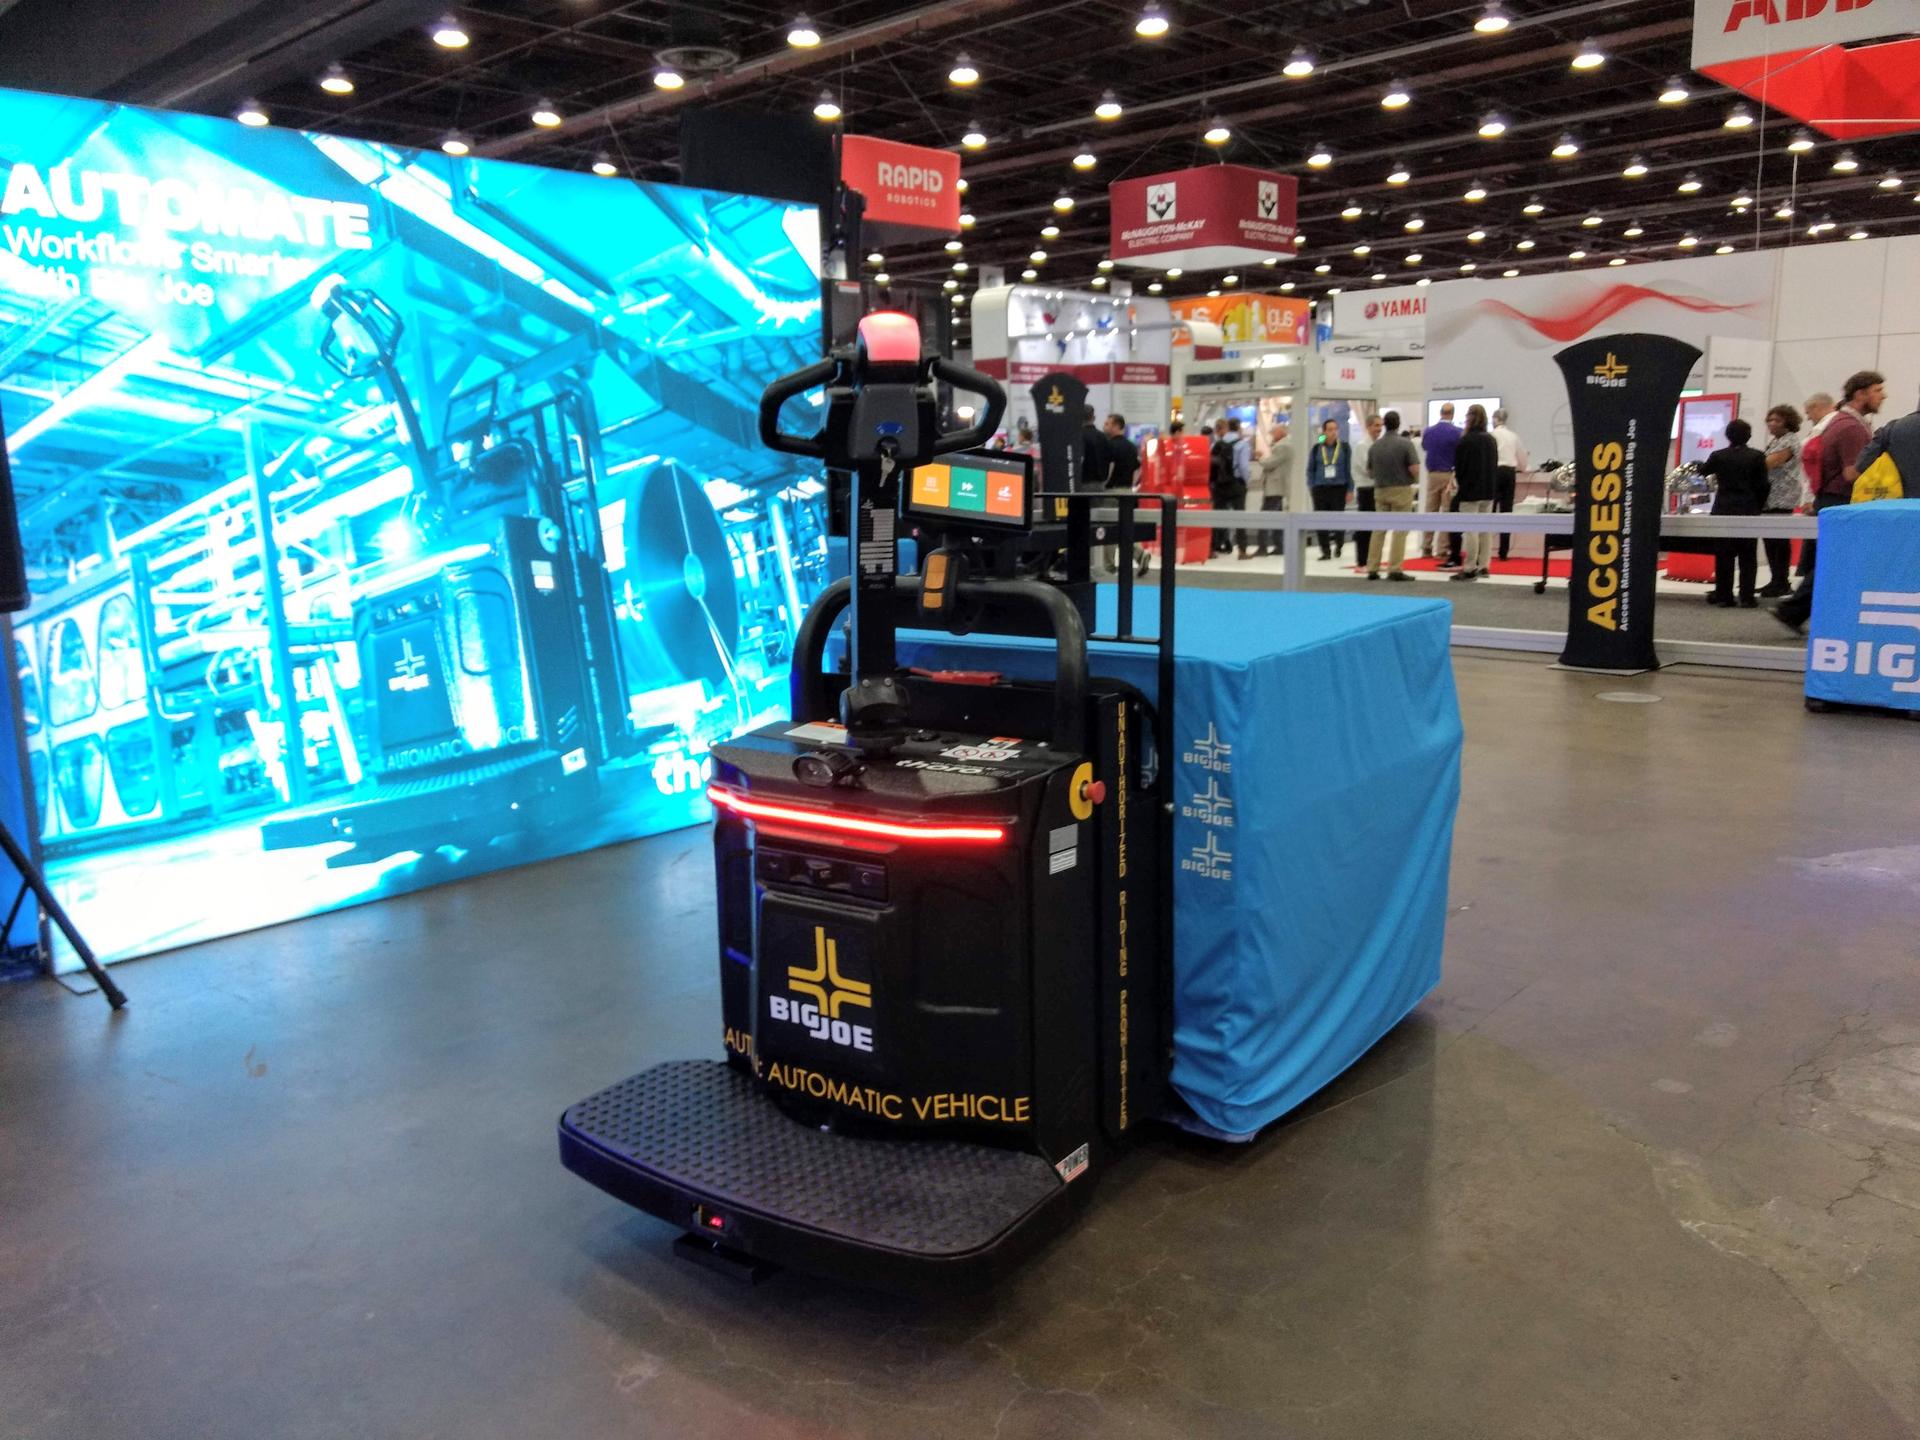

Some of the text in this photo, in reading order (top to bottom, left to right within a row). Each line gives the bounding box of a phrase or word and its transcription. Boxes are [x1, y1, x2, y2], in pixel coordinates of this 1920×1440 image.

[878, 162, 943, 193] RAPID
[887, 193, 937, 208] ROBOTICS
[1, 163, 372, 250] AUTOMATE
[3, 224, 184, 269] Workflows
[154, 273, 214, 306] Joe
[1587, 441, 1624, 631] ACCESS
[1619, 418, 1637, 631] Access Materials Smarter with Big Joe
[387, 739, 464, 771] AUTOMATIC
[1117, 700, 1128, 1130] UNAUTHORIZED RIDING PROHIBITED
[768, 1062, 902, 1120] AUTOMATIC
[911, 1093, 1030, 1122] VEHICLE
